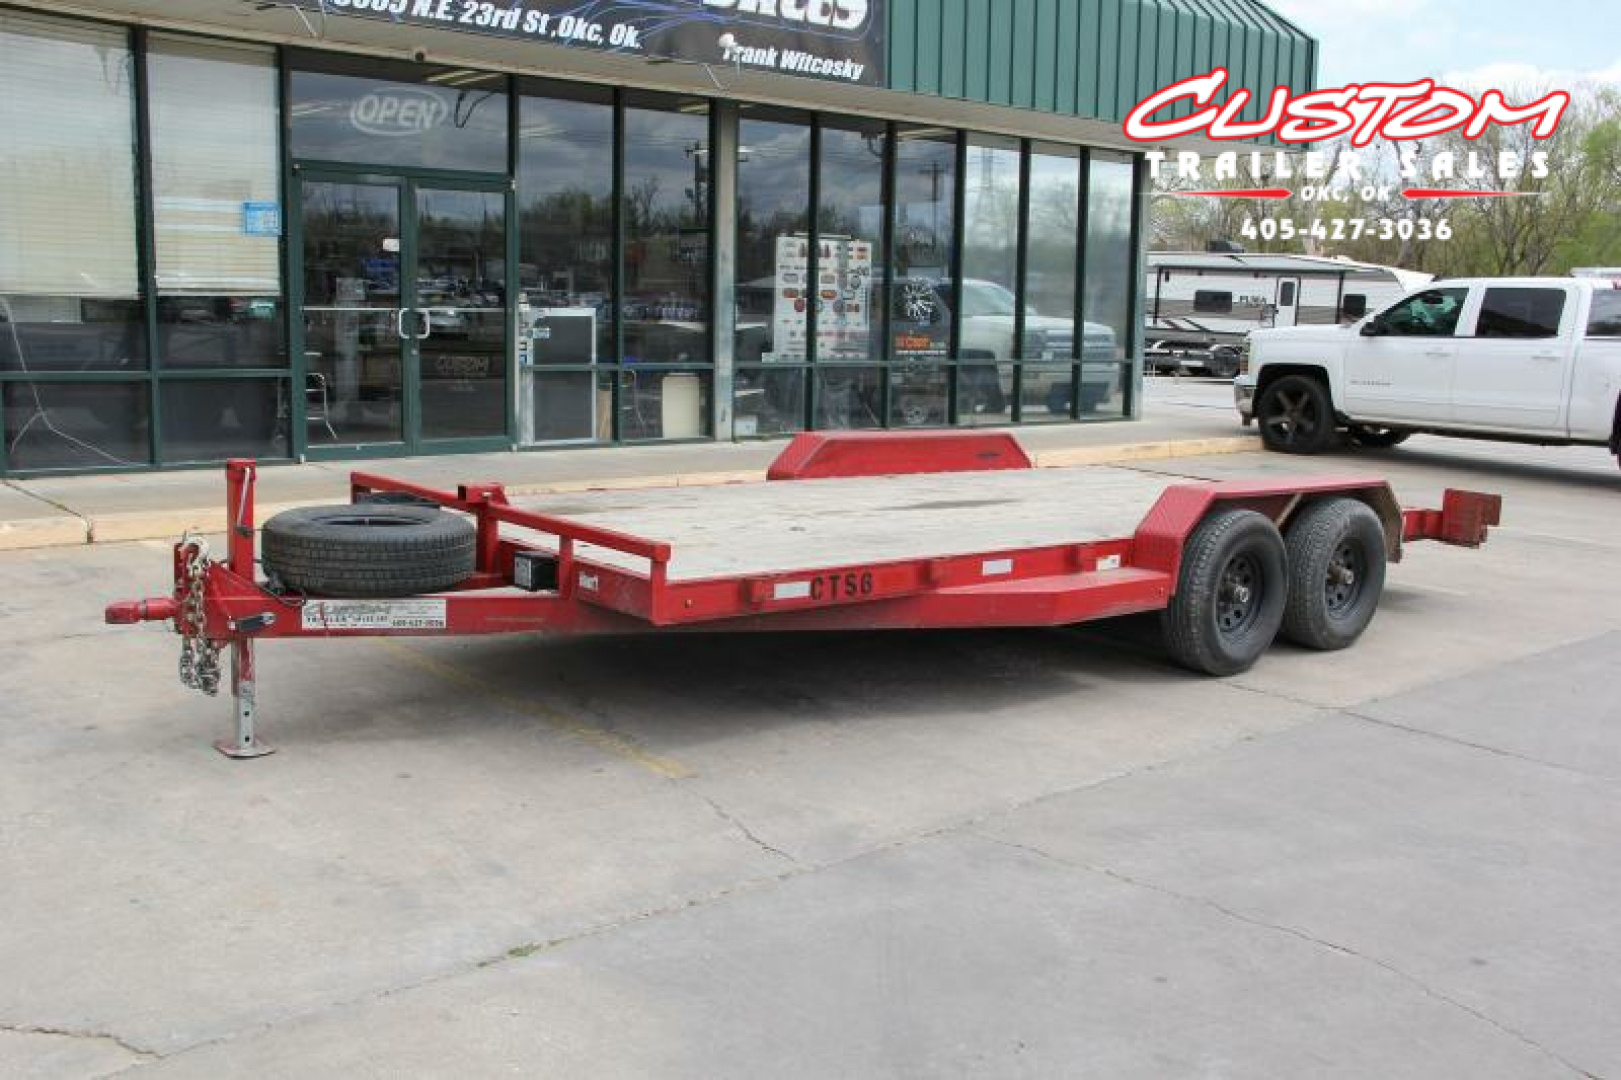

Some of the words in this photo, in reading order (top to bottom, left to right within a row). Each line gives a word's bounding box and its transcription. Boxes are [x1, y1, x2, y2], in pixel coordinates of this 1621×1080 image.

[458, 1, 522, 29] 23rd
[522, 9, 549, 35] St
[779, 48, 864, 81] Witcosky
[357, 94, 439, 130] OPEN
